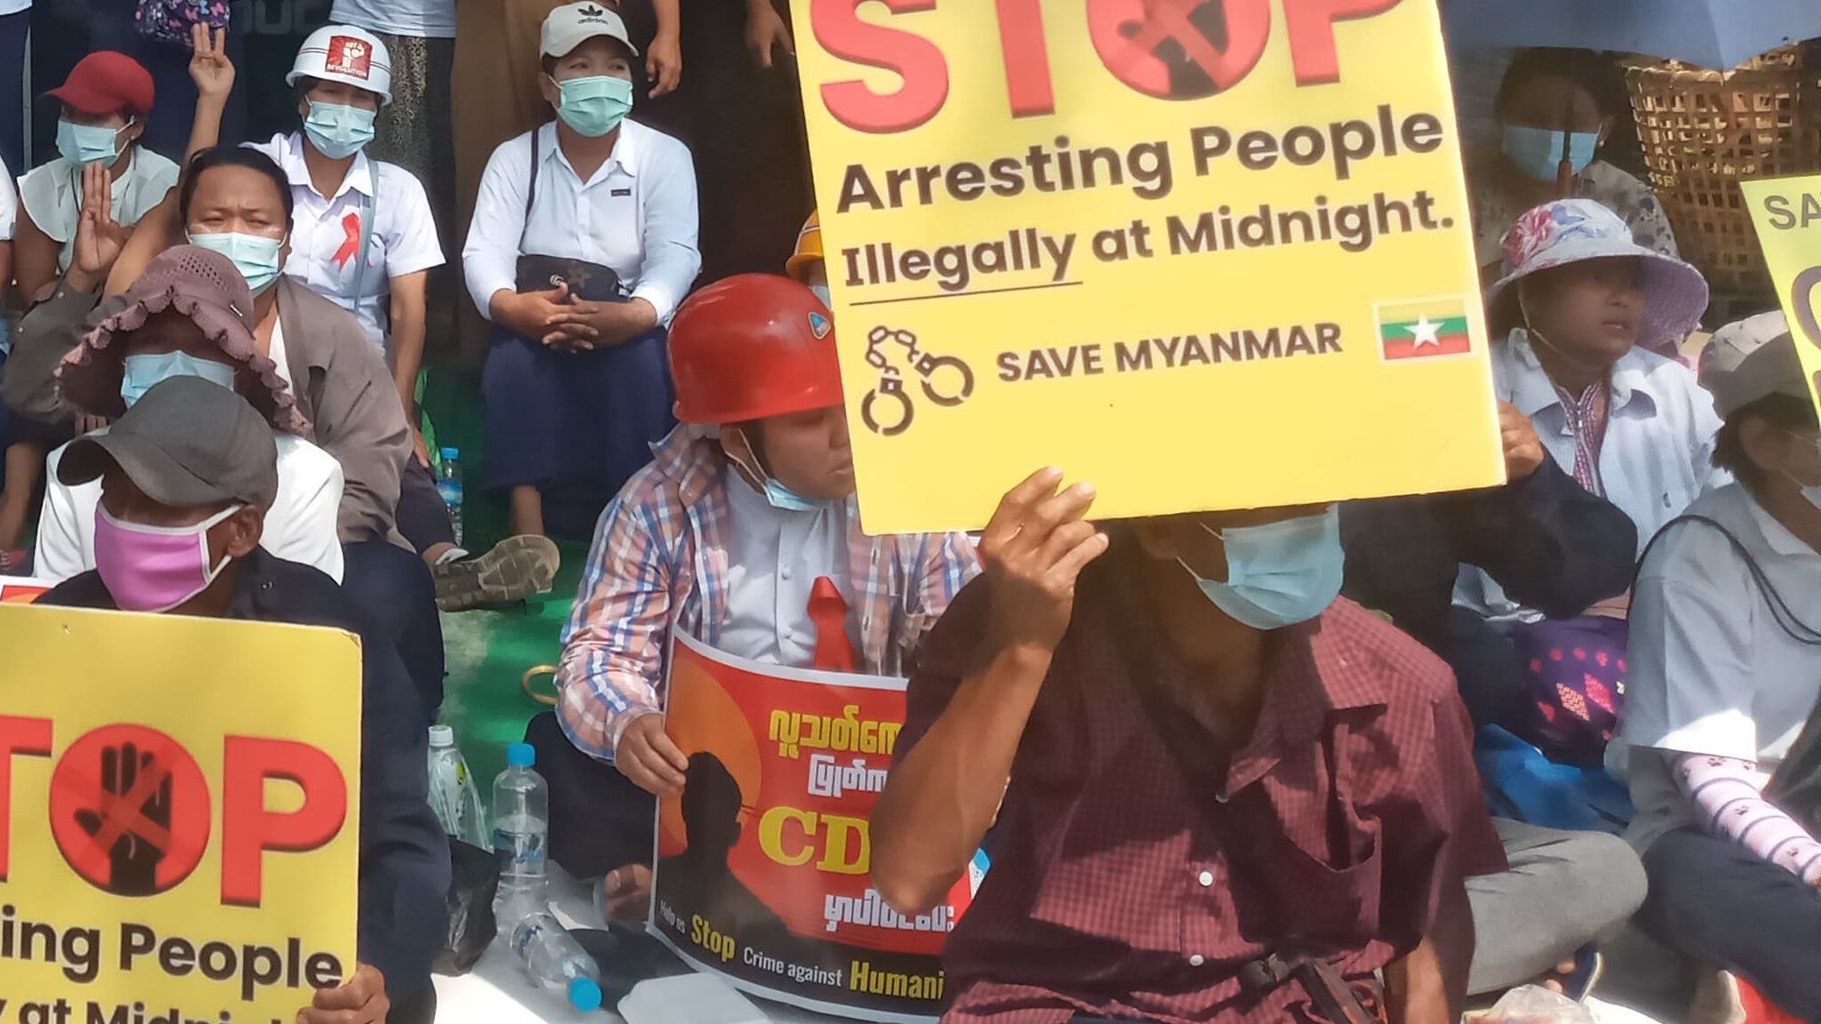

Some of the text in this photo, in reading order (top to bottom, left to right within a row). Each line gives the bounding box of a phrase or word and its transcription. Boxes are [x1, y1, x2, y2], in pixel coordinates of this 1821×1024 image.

[836, 104, 1444, 214] Arresting People
[841, 188, 1455, 294] Illegally at Midnight.
[1764, 192, 1821, 230] SA
[996, 321, 1344, 383] SAVE MYANMAR
[759, 806, 871, 874] CD
[119, 922, 343, 1001] People
[691, 913, 736, 963] Stop
[744, 947, 784, 974] Crime
[788, 963, 842, 988] against
[850, 960, 945, 1001] Humani
[18, 998, 72, 1024] at
